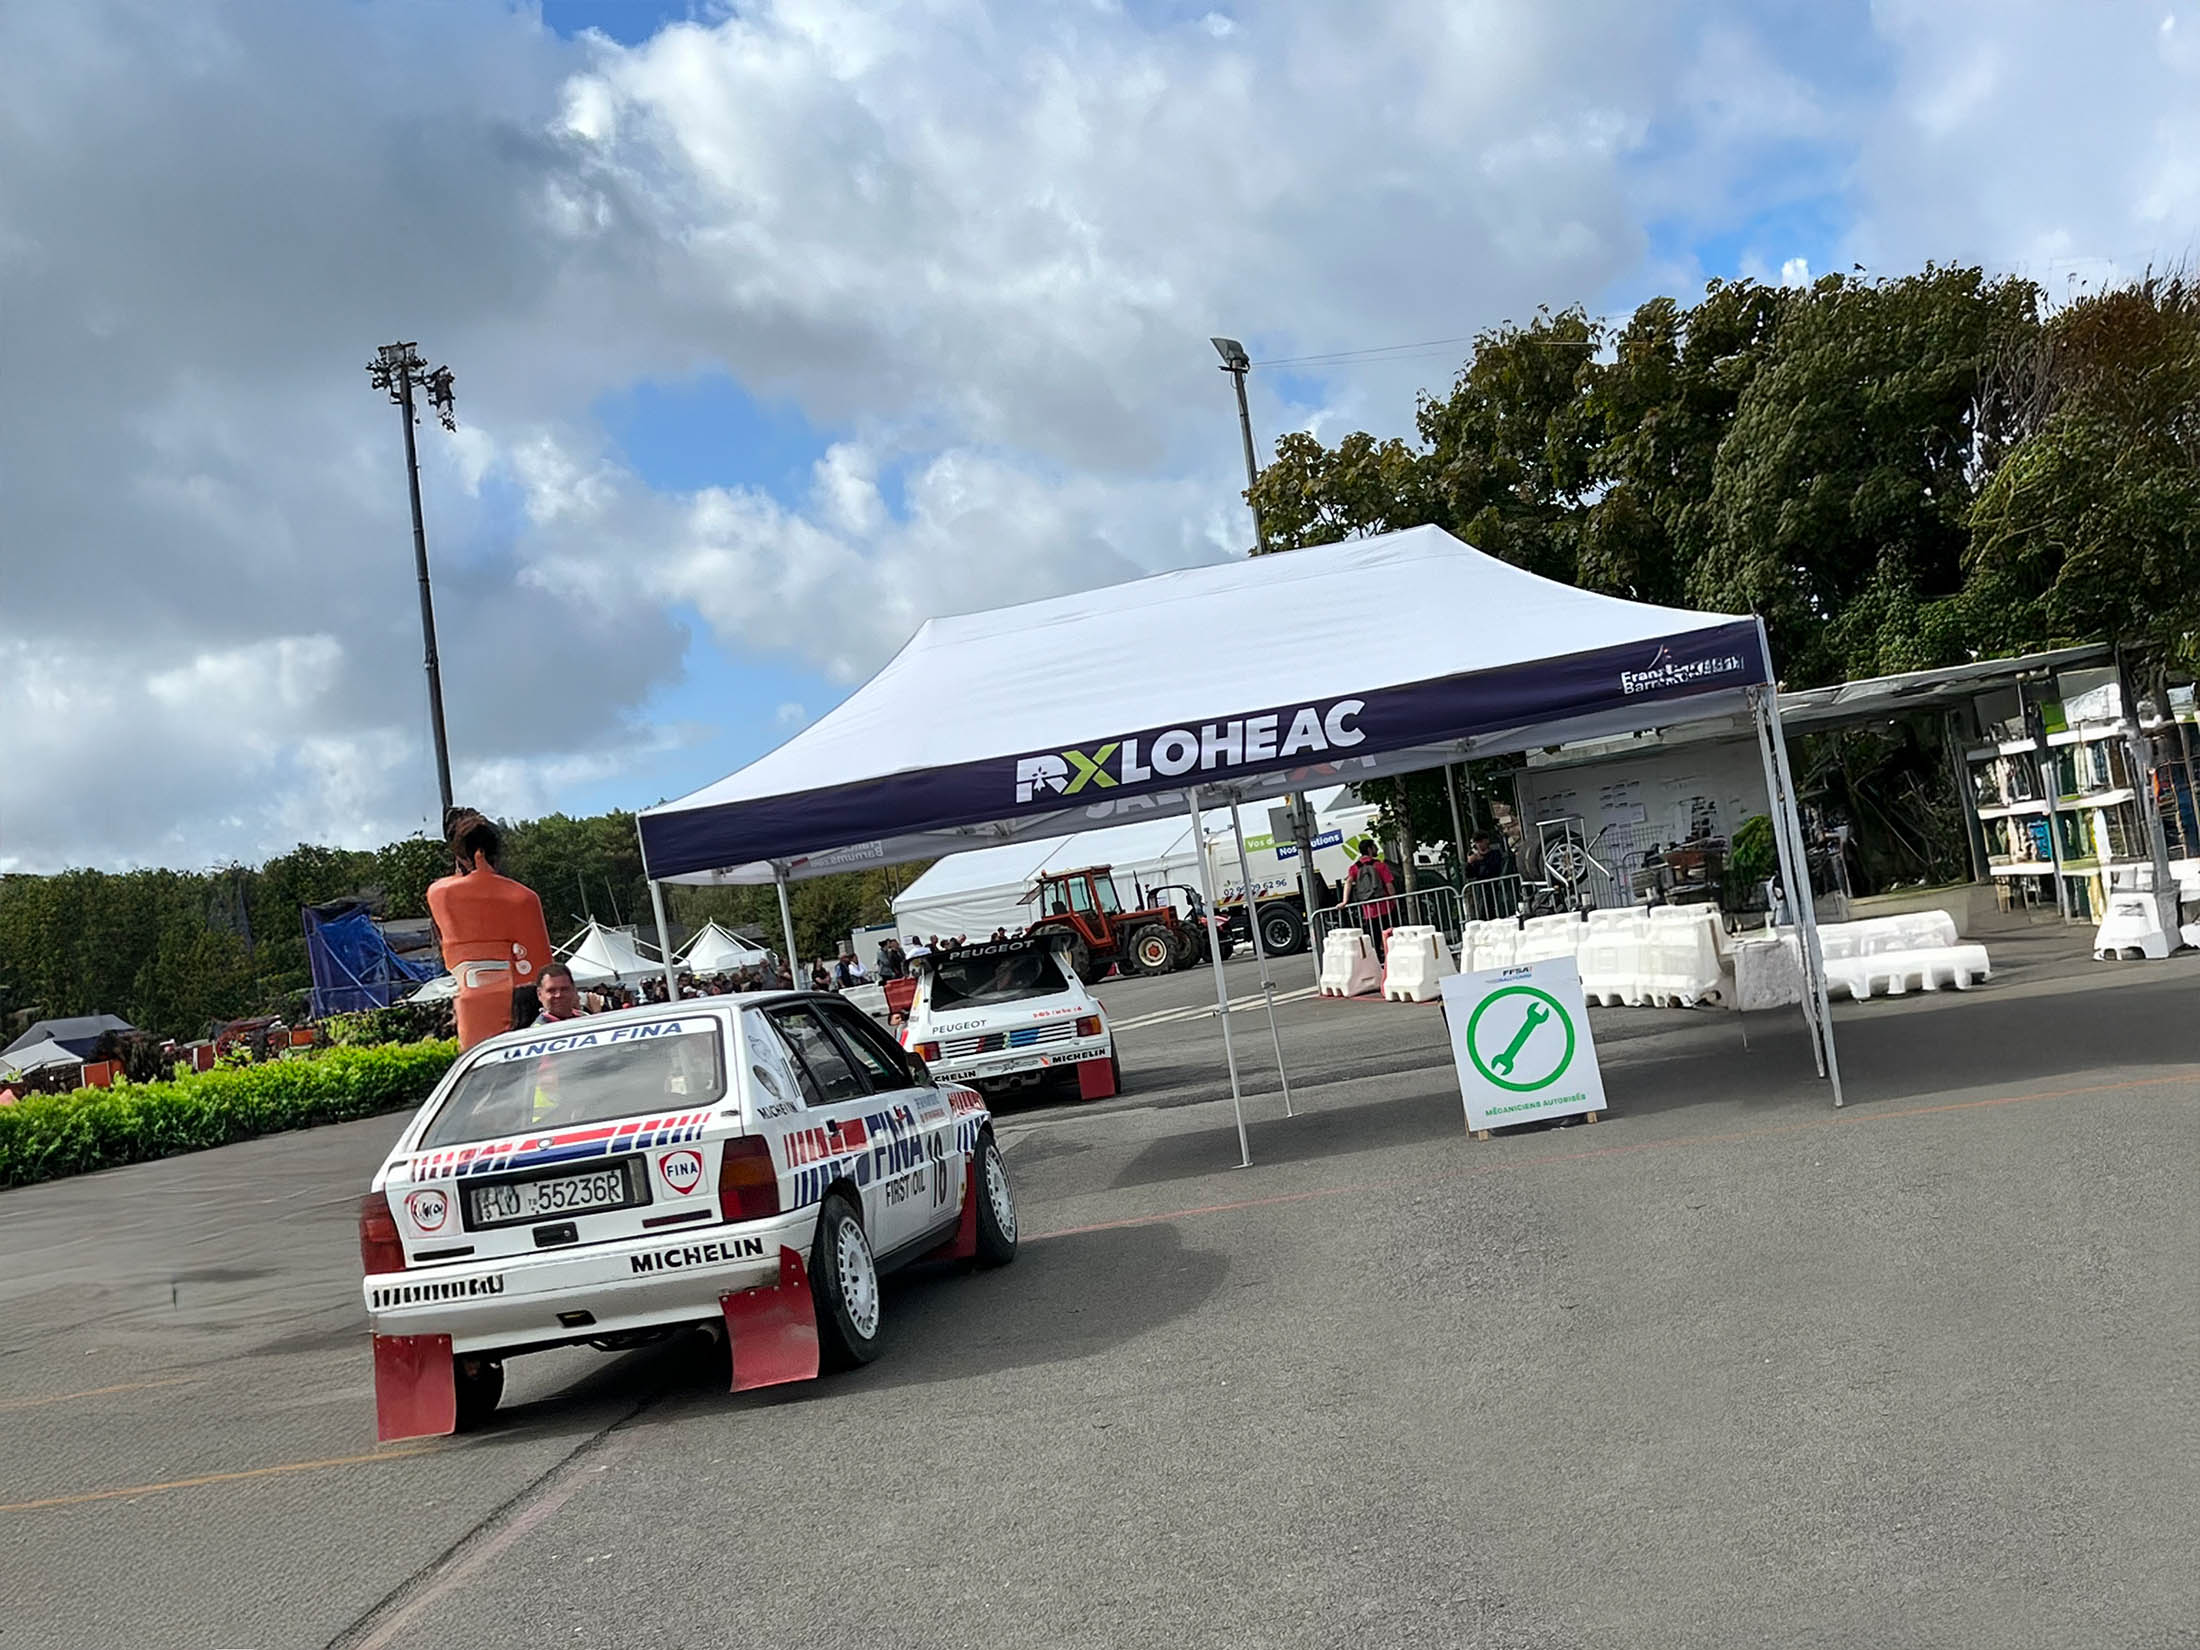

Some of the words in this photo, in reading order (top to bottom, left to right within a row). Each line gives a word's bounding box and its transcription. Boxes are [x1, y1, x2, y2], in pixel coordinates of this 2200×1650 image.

[1280, 846, 1297, 856] Nos
[1311, 834, 1340, 847] utions
[949, 939, 1034, 960] PEUGEOT
[610, 1023, 682, 1042] FINA
[932, 1019, 987, 1034] PEUGEOT
[1052, 1049, 1106, 1063] MICHELIN
[935, 1071, 976, 1082] CHELIN
[666, 1162, 699, 1178] FINA
[886, 1175, 909, 1208] FIRST
[630, 1237, 763, 1273] MICHELIN
